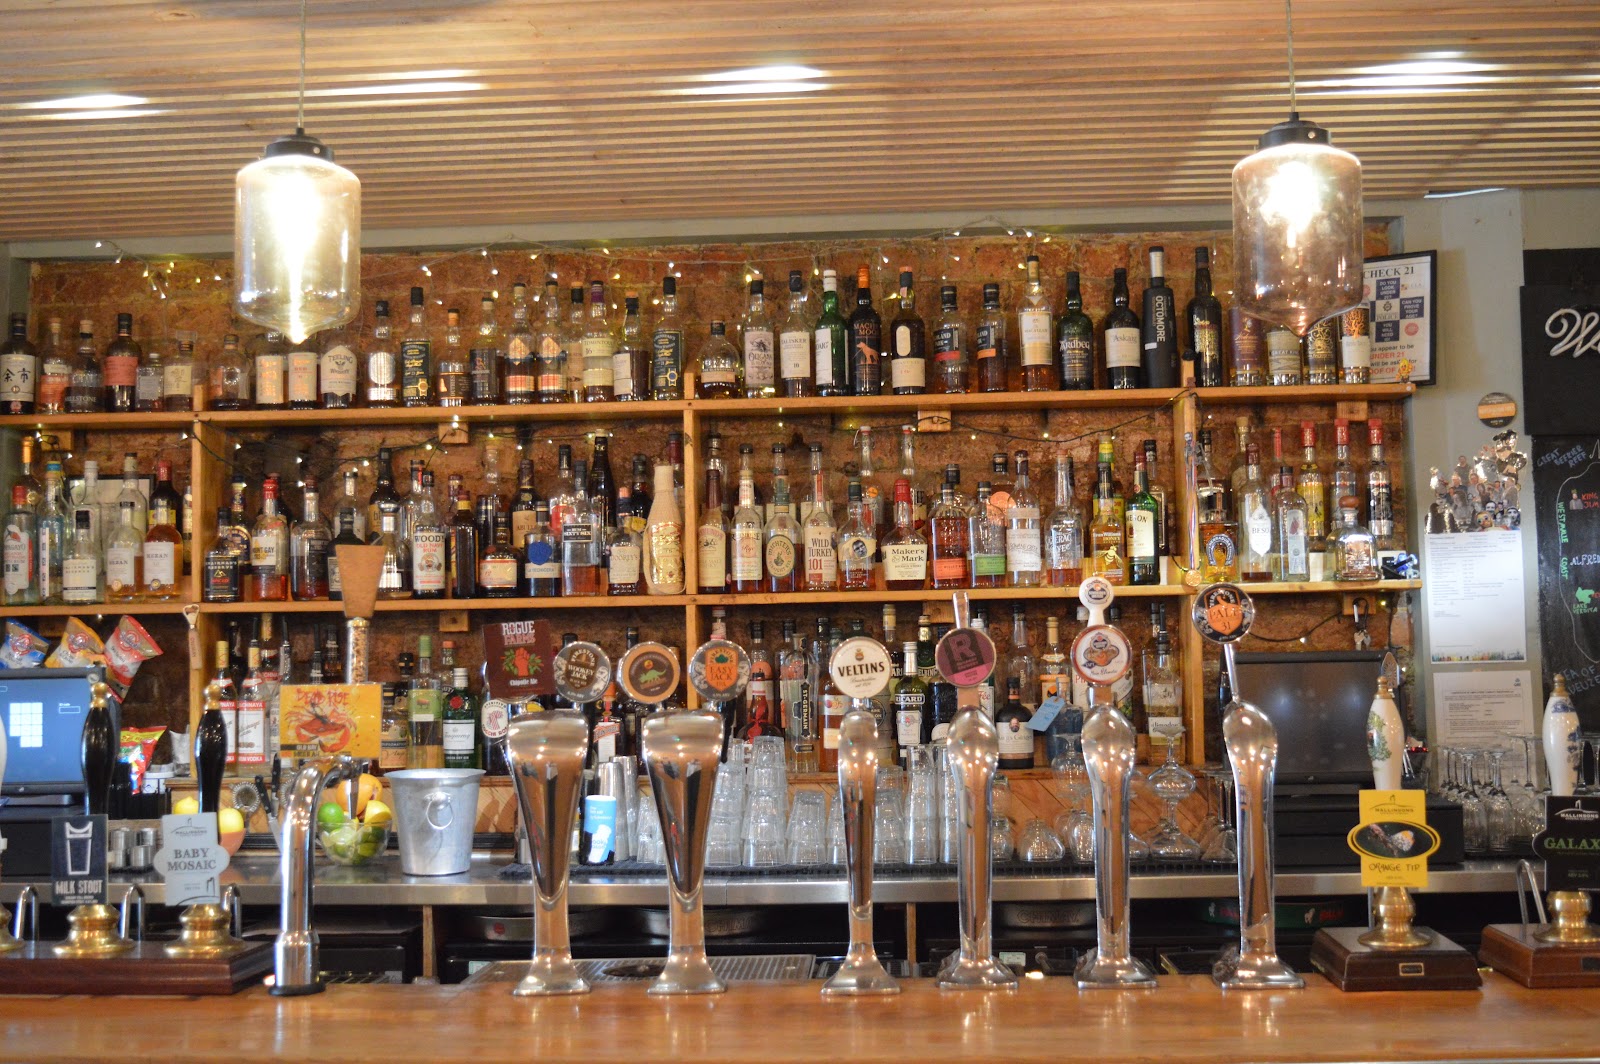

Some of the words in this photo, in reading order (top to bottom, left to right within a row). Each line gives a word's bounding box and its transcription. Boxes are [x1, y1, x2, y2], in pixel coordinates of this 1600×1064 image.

[1363, 267, 1401, 279] CHECK
[1404, 266, 1414, 275] 21
[1155, 295, 1165, 342] OCTOMORE
[328, 355, 353, 364] TEELING
[3, 367, 31, 383] 余市
[811, 538, 830, 547] WILD
[808, 547, 832, 557] TURKEY
[808, 558, 823, 570] 101
[1560, 556, 1568, 580] COAST
[1209, 608, 1238, 620] PALE
[501, 621, 535, 636] ROGUE
[503, 632, 536, 645] FARMS
[568, 664, 595, 676] WOOKEY
[572, 671, 587, 680] JACK
[710, 666, 732, 674] EASY
[838, 662, 885, 677] VELTINS
[711, 673, 732, 681] JACK
[1543, 837, 1600, 850] GALAX
[174, 848, 209, 859] BABY
[168, 859, 216, 871] MOSAIC
[1369, 862, 1401, 873] ORANGE
[1405, 863, 1420, 871] TIP
[56, 881, 75, 894] MILK
[78, 880, 103, 893] STOUT
